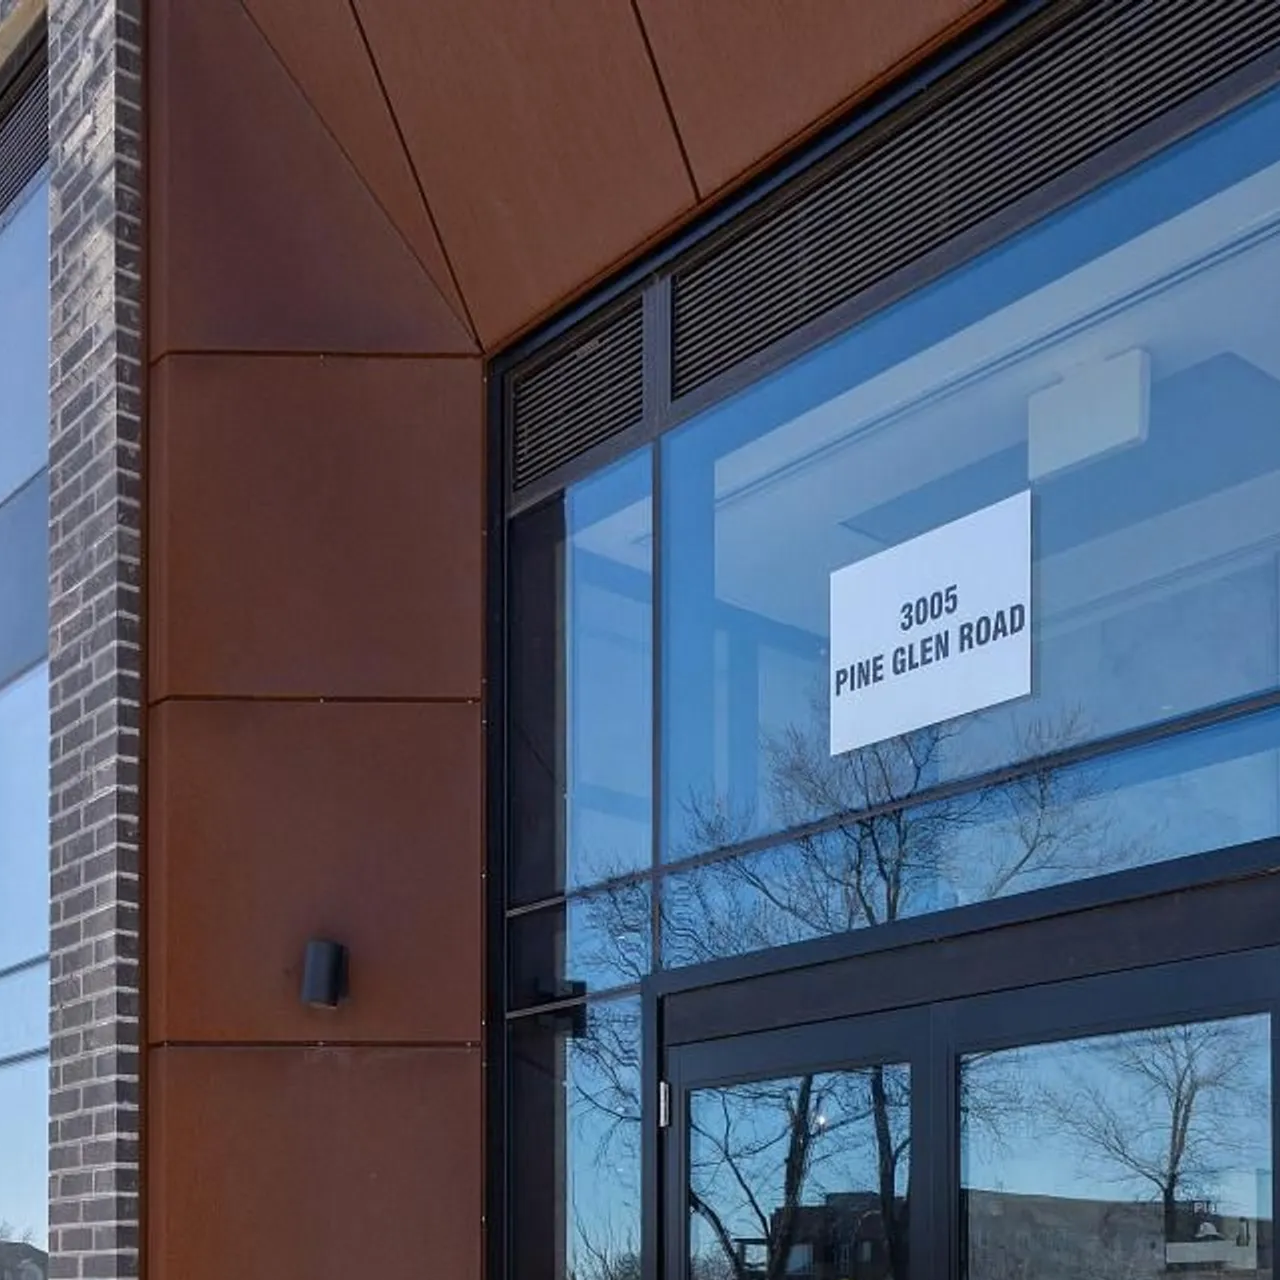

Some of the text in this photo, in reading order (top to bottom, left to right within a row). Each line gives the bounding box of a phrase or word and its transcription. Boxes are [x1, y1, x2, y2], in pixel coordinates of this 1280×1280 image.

[899, 584, 958, 632] 3005
[835, 603, 1026, 697] PINE GLEN ROAD
